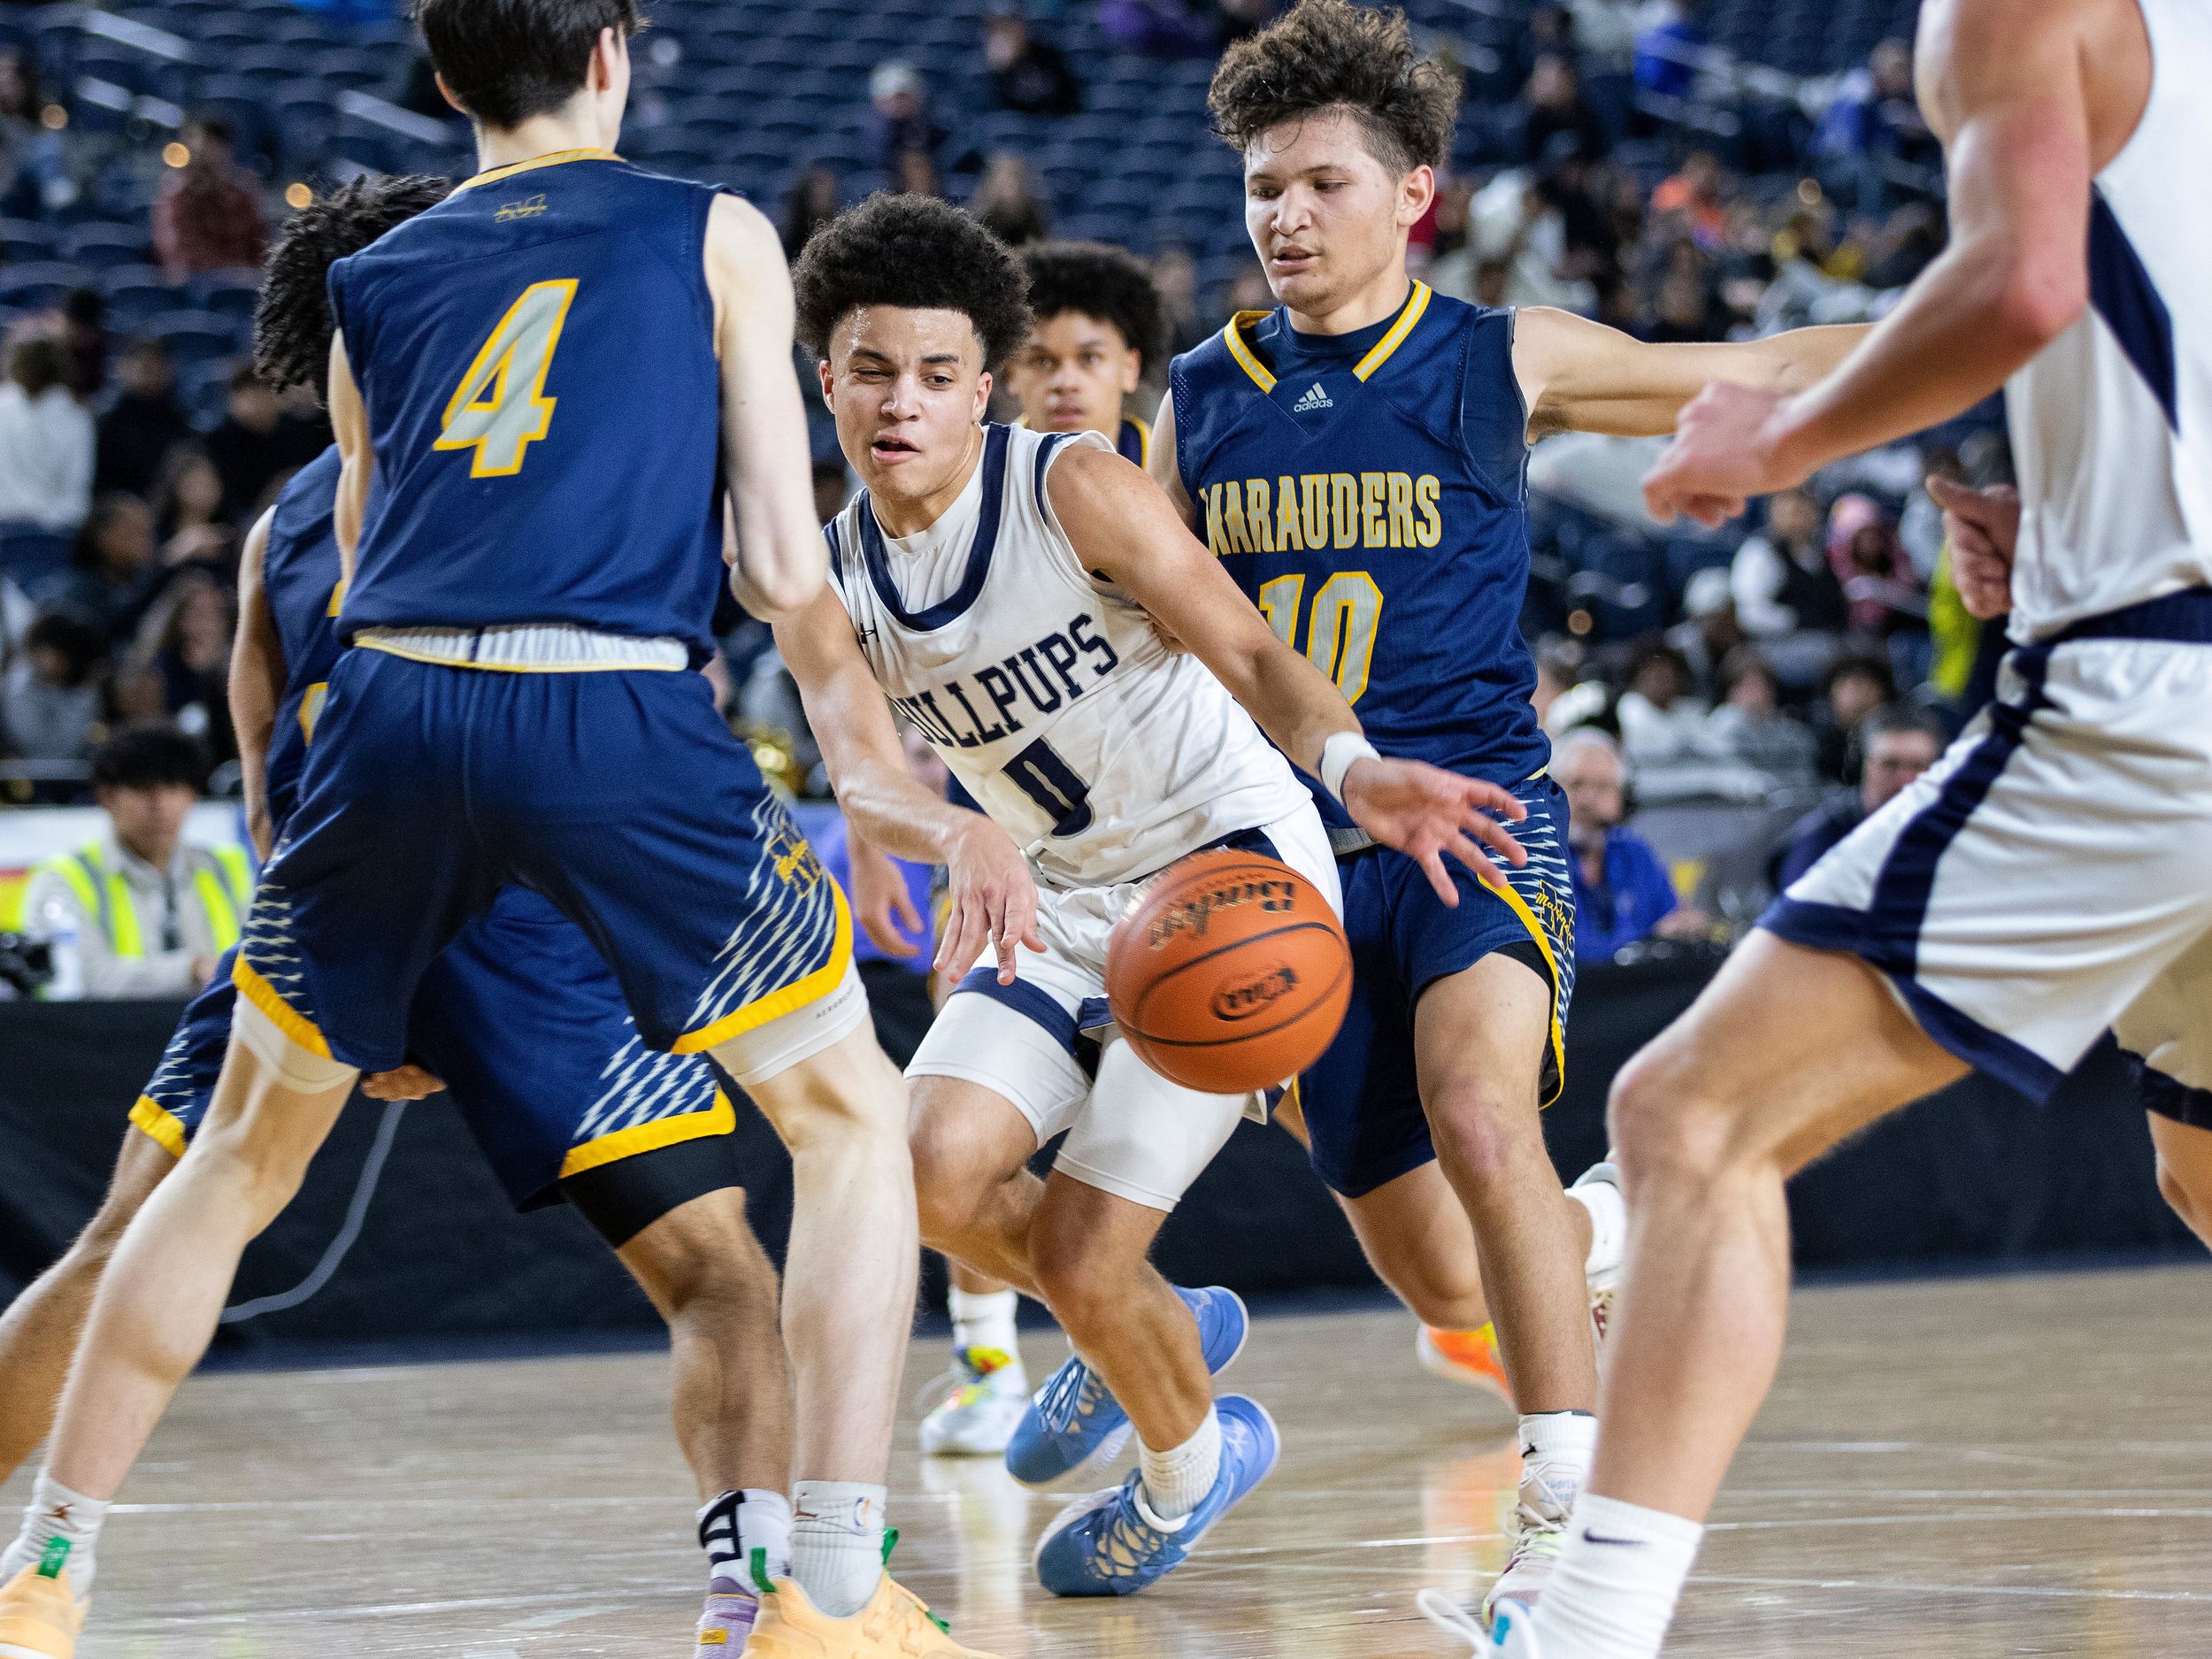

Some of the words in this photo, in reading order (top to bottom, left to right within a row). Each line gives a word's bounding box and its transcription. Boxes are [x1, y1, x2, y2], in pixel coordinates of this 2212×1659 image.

[432, 278, 580, 479] 4
[1294, 398, 1333, 413] adidas
[1257, 570, 1385, 708] 10
